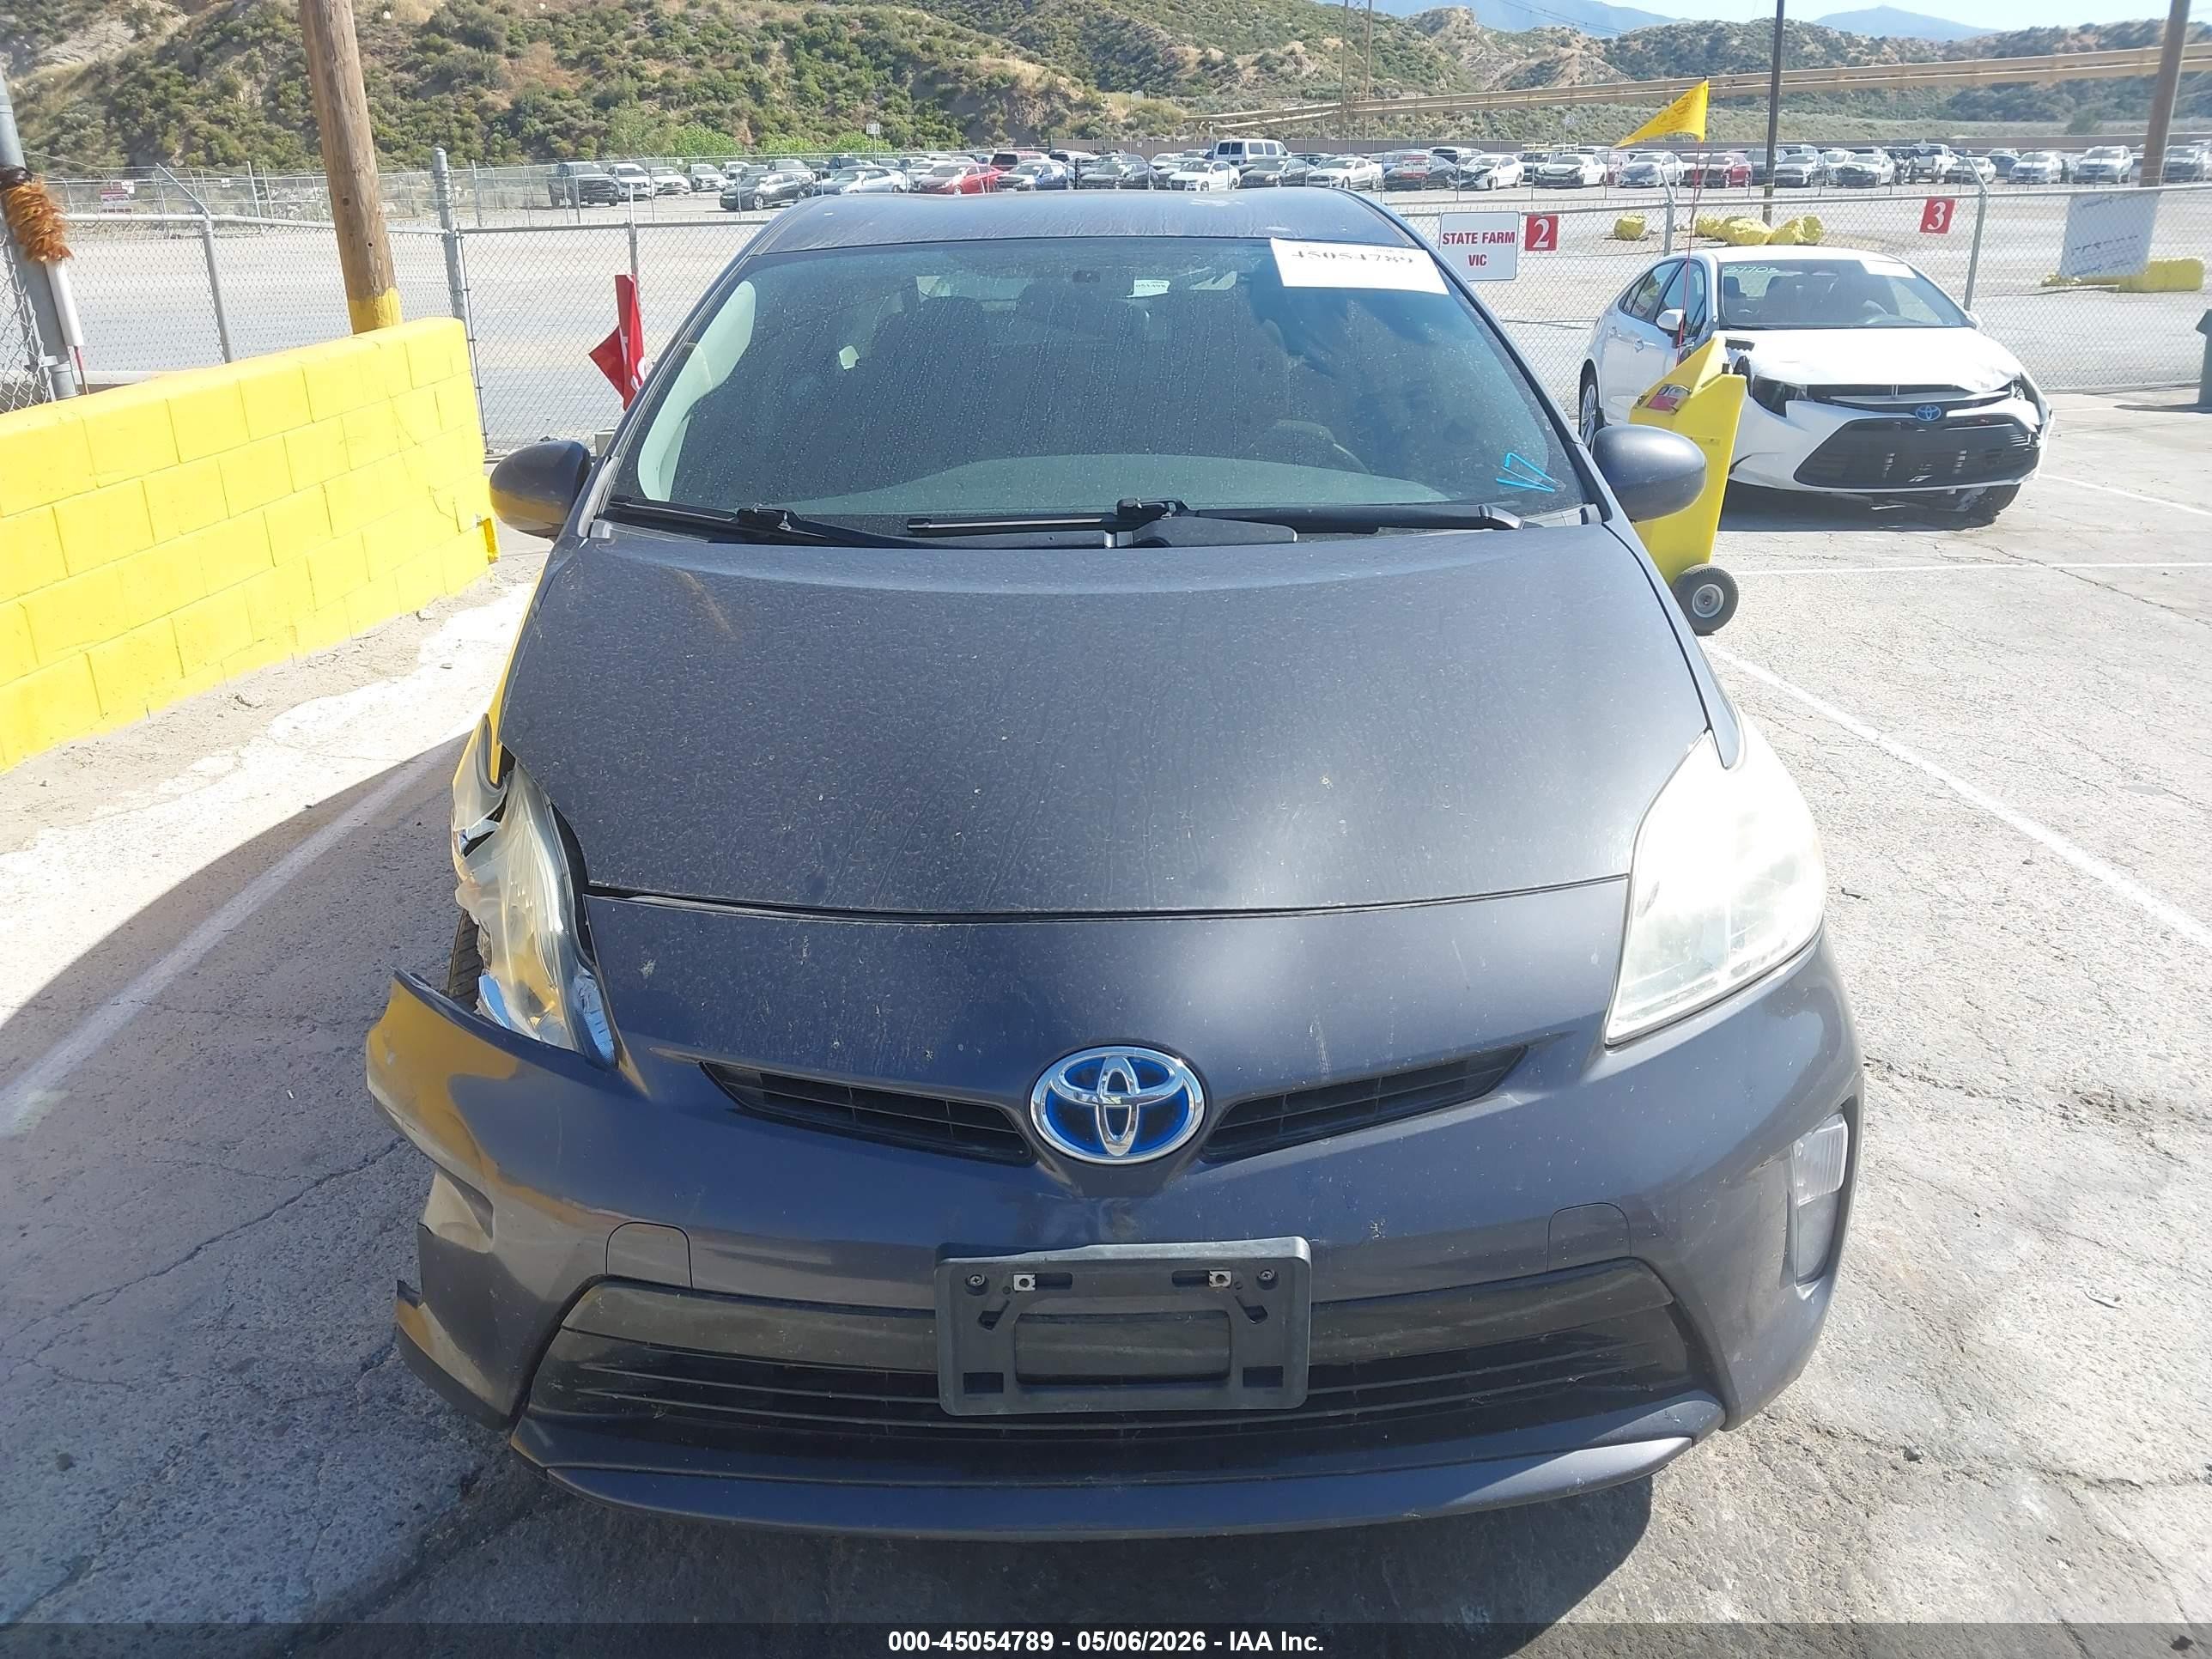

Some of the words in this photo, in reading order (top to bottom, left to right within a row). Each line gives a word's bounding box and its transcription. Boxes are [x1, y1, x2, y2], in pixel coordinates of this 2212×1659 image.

[1926, 201, 1947, 230] 3
[1442, 232, 1479, 246] STATE
[1481, 231, 1516, 245] FARM
[1532, 218, 1551, 248] 2
[1468, 254, 1487, 266] VIC
